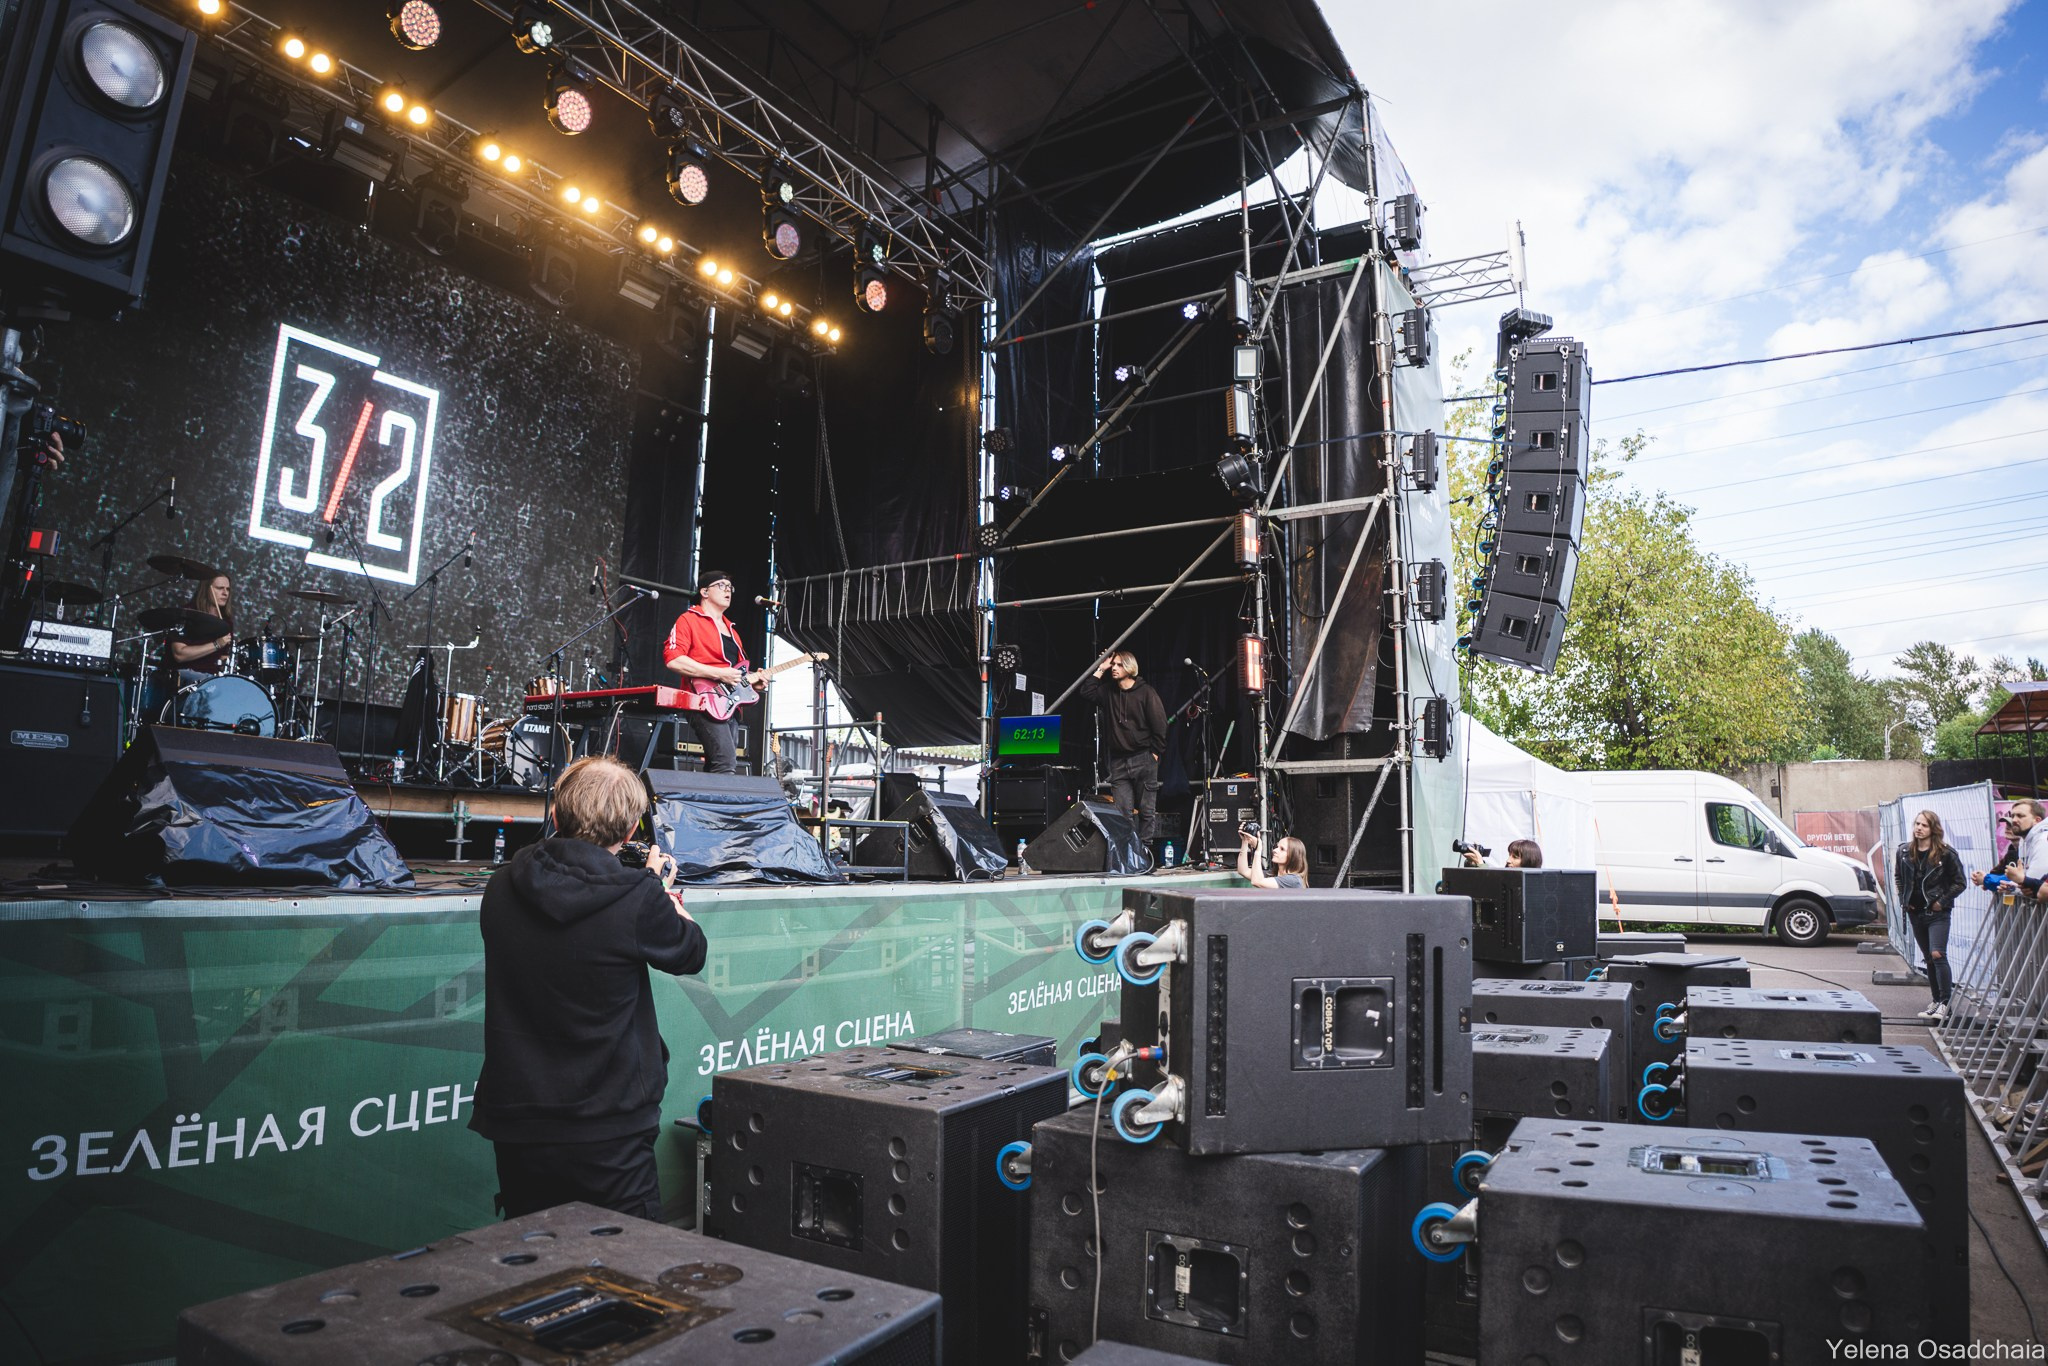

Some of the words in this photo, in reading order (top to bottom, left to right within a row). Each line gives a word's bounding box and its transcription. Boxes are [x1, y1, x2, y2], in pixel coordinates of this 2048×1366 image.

[278, 363, 417, 552] 3/2
[16, 732, 64, 743] MESA
[523, 723, 551, 734] TAMA
[1013, 727, 1045, 740] 62:13
[1806, 832, 1833, 841] ДРУГОЙ
[1833, 845, 1860, 853] ПИТЕРА
[1007, 980, 1073, 1015] ЗЕЛЁНАЯ
[1077, 971, 1122, 998] СЦЕНА
[1324, 996, 1333, 1052] COBRA-TOP
[697, 1025, 826, 1076] ЗЕЛЁНАЯ
[835, 1010, 915, 1047] СЦЕНА
[27, 1106, 326, 1181] ЗЕЛЁНАЯ
[349, 1080, 478, 1138] СЦЕН
